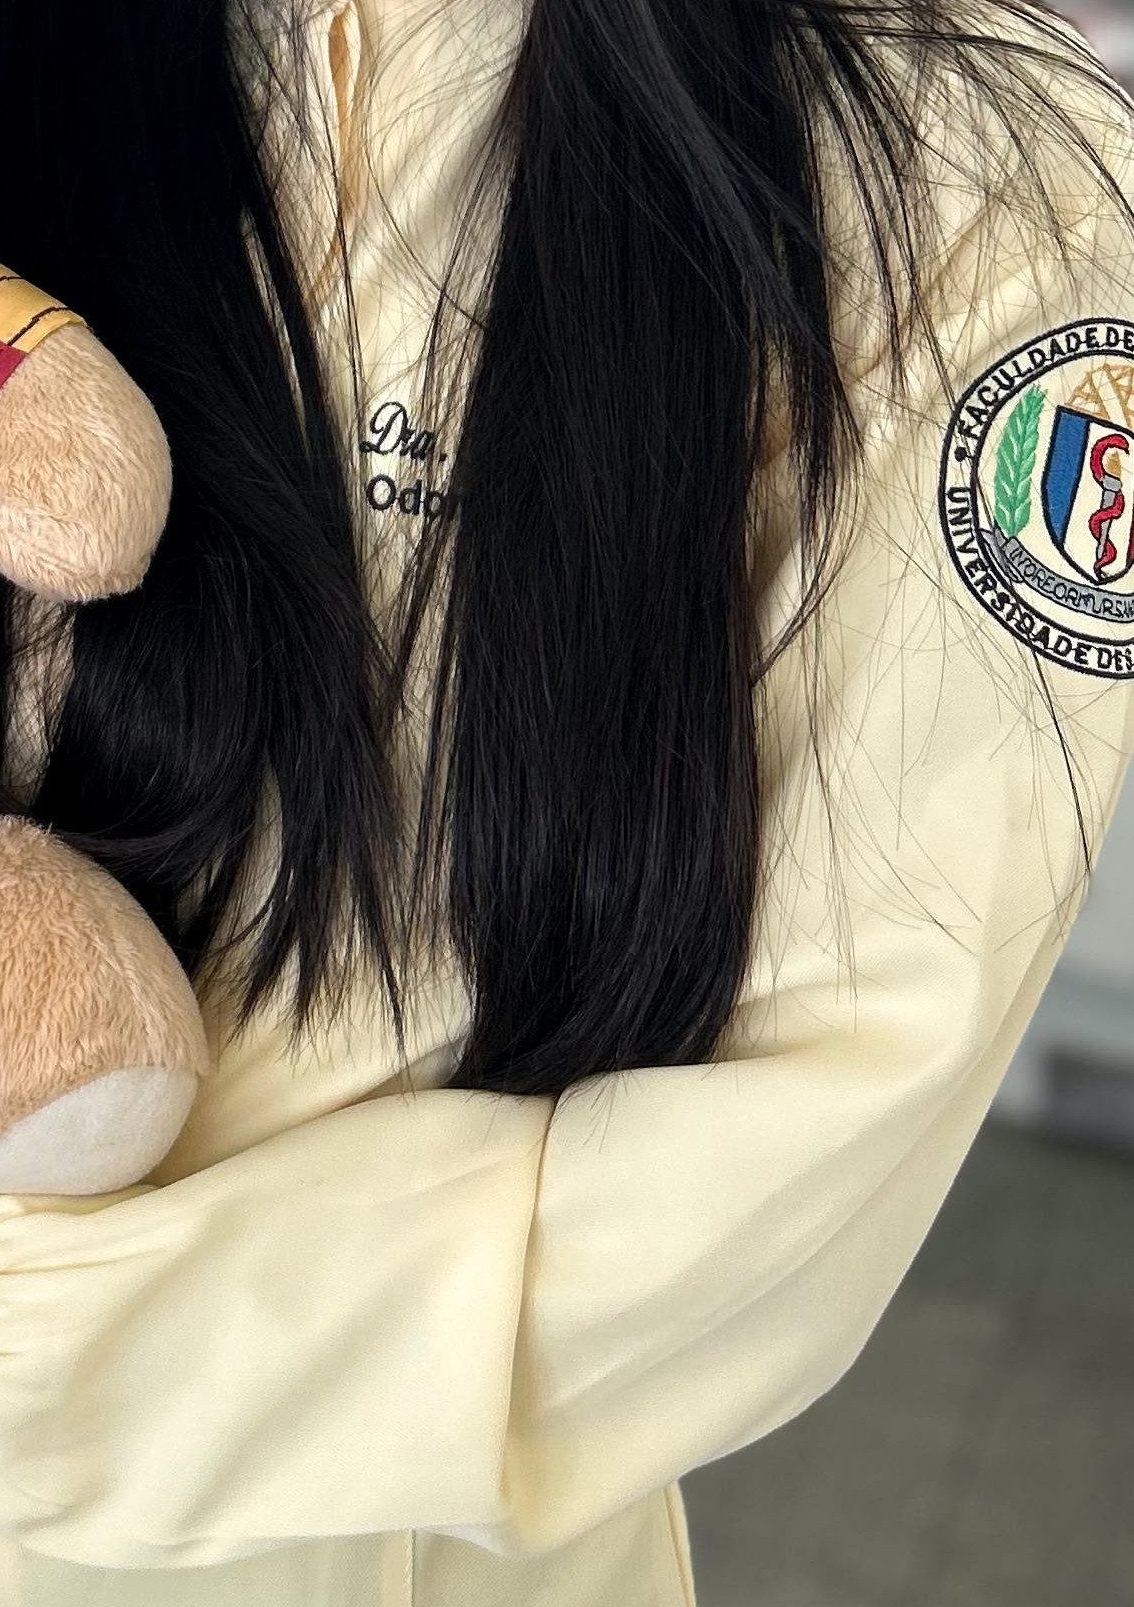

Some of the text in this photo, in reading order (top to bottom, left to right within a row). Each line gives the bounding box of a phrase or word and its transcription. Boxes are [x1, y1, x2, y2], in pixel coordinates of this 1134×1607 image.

[958, 326, 1134, 439] FACULDADE DE
[947, 486, 1091, 665] UNIVERSIDADE
